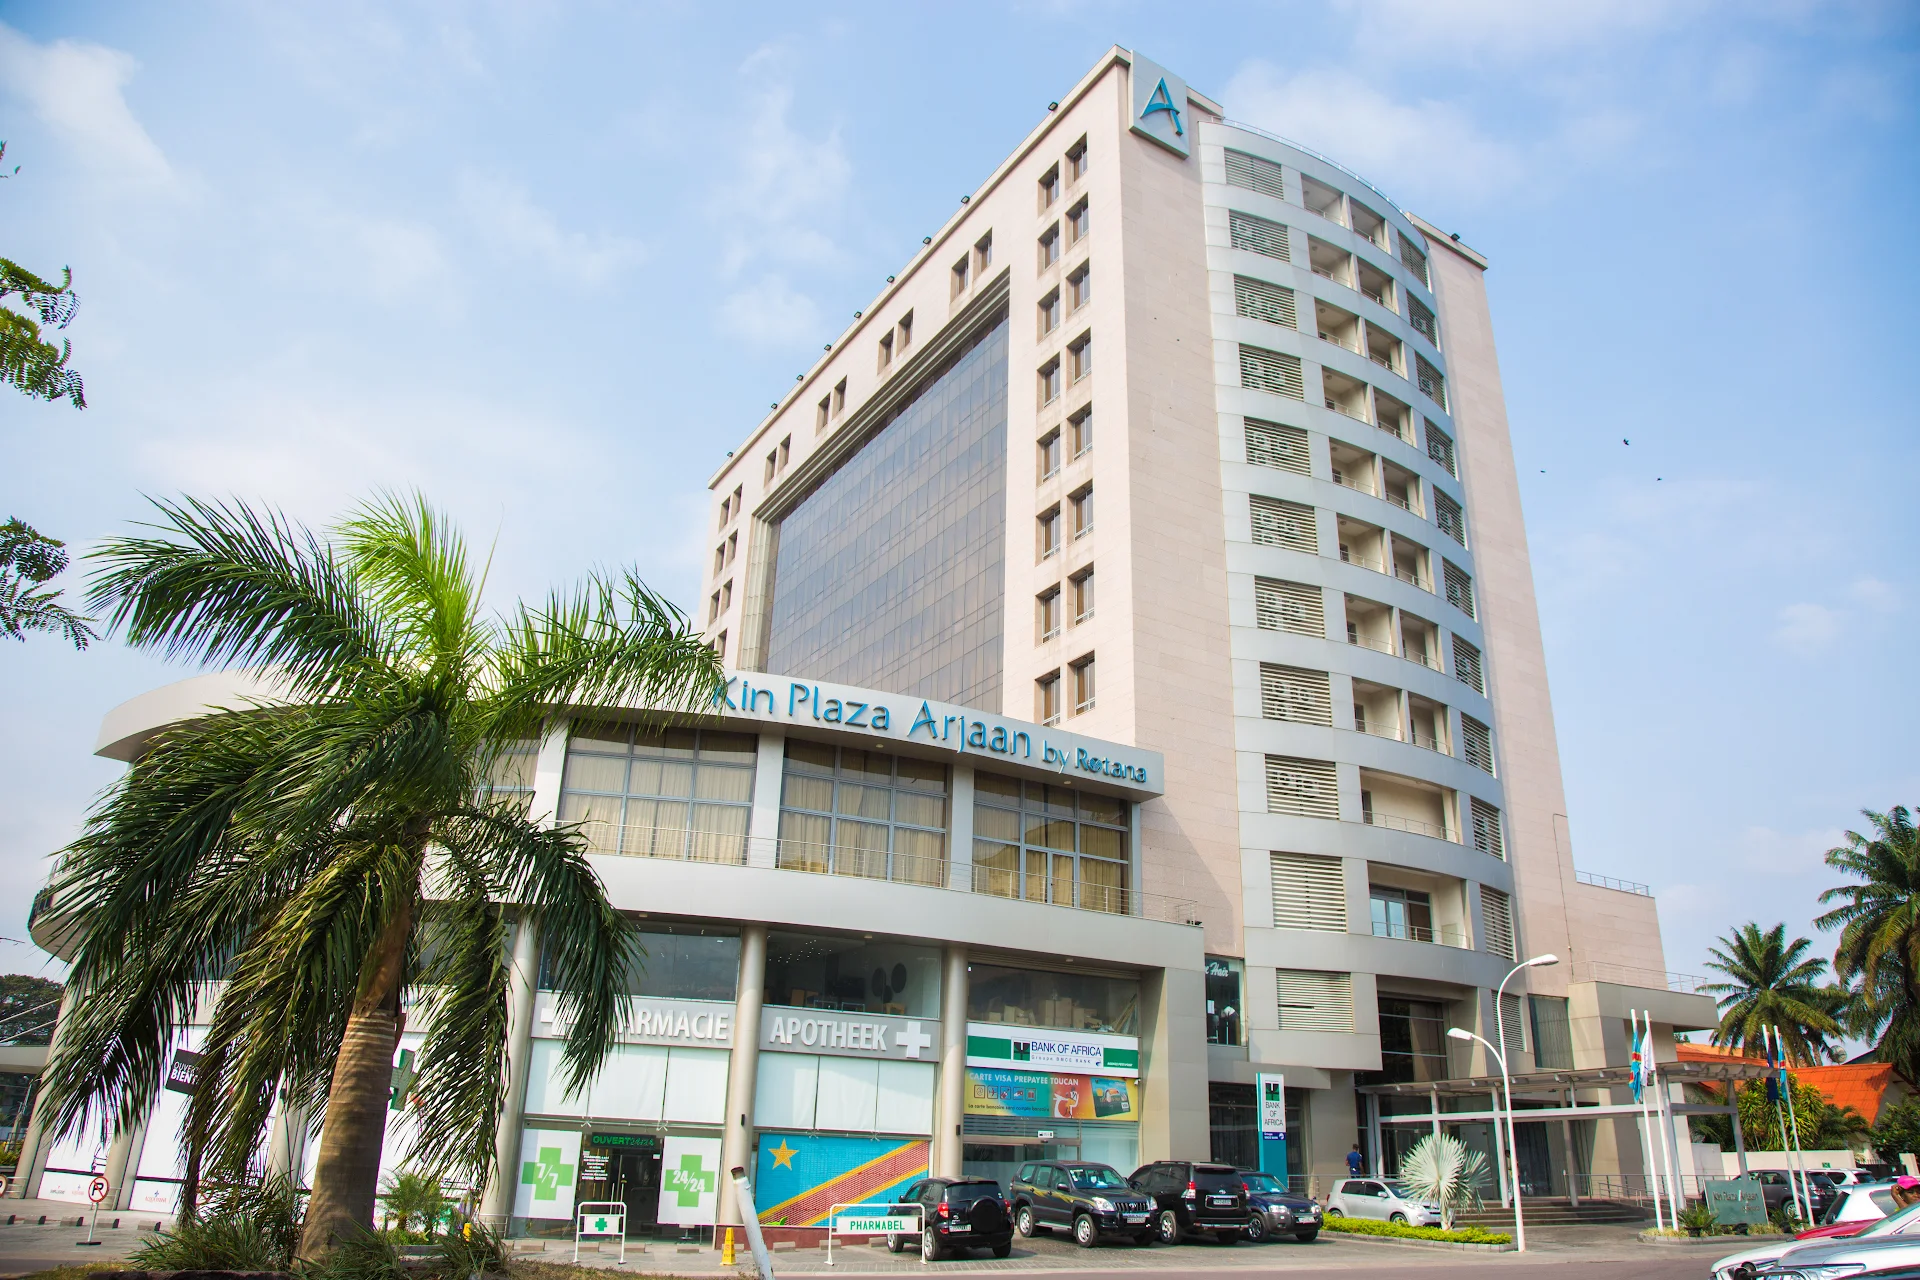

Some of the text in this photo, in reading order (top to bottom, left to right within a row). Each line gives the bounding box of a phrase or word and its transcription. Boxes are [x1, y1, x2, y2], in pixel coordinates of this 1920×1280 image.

[712, 675, 1147, 783] Kin Plaza Arjaan by Rotana
[598, 1005, 730, 1041] ARMACIE
[769, 1016, 888, 1051] APOTHEEK
[1031, 1041, 1102, 1057] BANK OF AFRICA
[969, 1073, 1079, 1086] CARTE VISA PREPAYEE TOUCAN
[1265, 1101, 1281, 1109] BANK
[1269, 1110, 1278, 1118] OF
[1264, 1118, 1284, 1127] AFRICA
[592, 1135, 630, 1146] OUVERT
[536, 1163, 559, 1189] 7/7
[672, 1169, 706, 1192] 24/24
[850, 1220, 906, 1231] PHARMABEL
